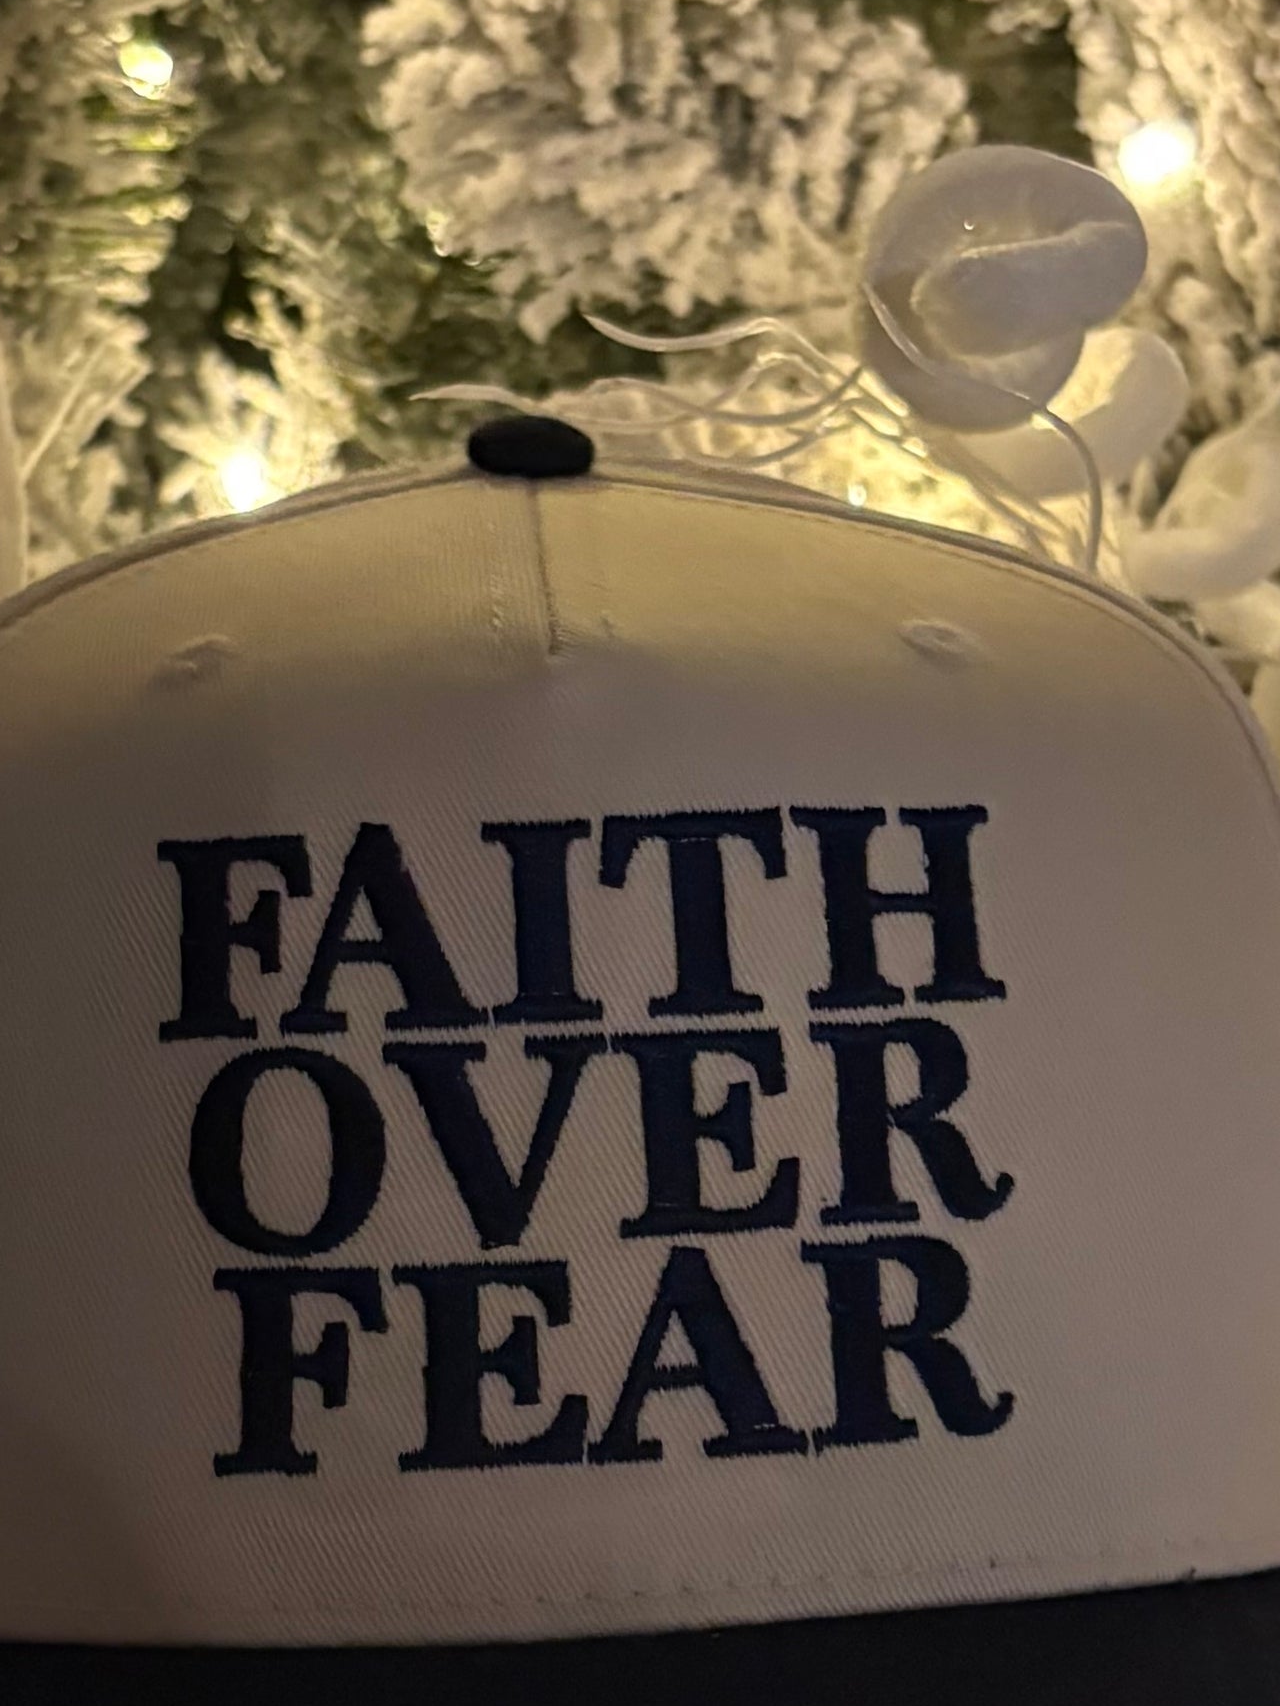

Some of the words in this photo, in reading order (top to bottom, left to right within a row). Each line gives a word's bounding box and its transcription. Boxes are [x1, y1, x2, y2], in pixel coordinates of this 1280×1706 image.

[156, 804, 1007, 1043] FAITH
[188, 1017, 1015, 1257] OVER
[213, 1234, 1015, 1477] FEAR
